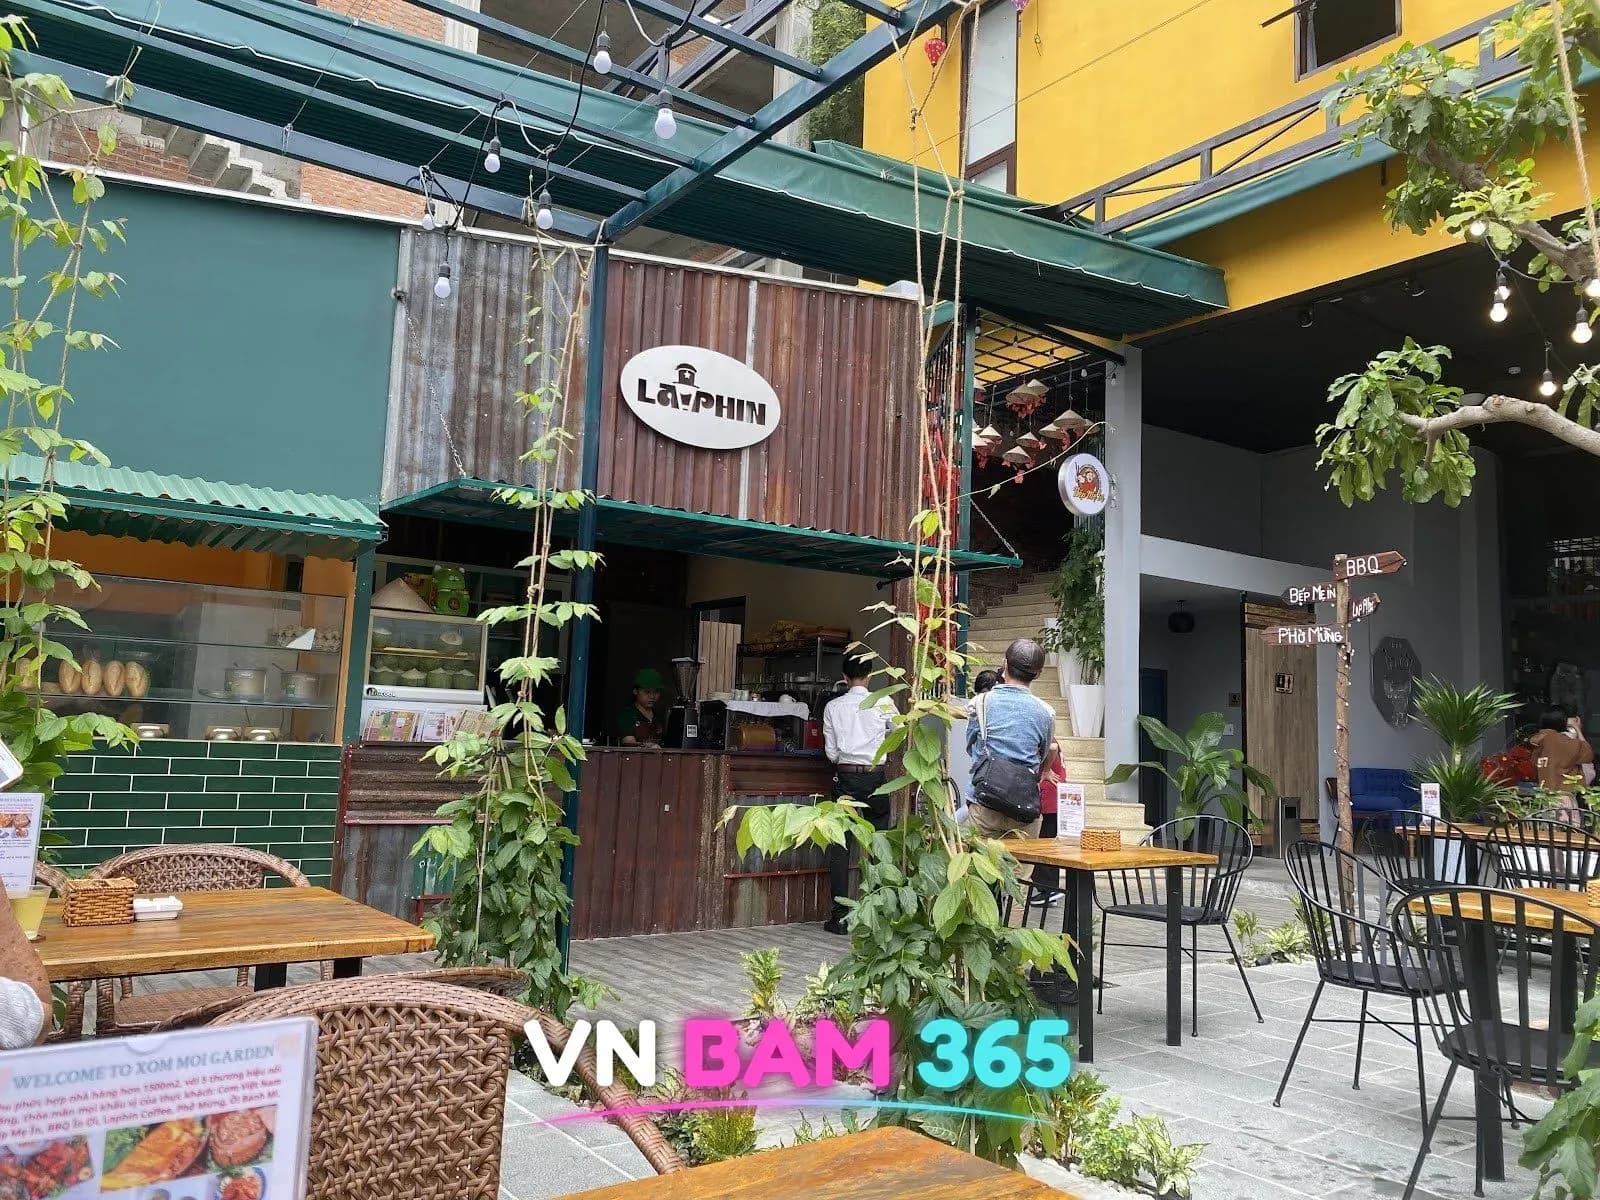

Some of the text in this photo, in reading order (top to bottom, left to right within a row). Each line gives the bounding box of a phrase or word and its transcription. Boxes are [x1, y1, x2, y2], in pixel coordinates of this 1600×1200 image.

[1346, 555, 1382, 577] BBQ
[13, 1045, 275, 1089] WELCOME TO XOM MOI GARDEN
